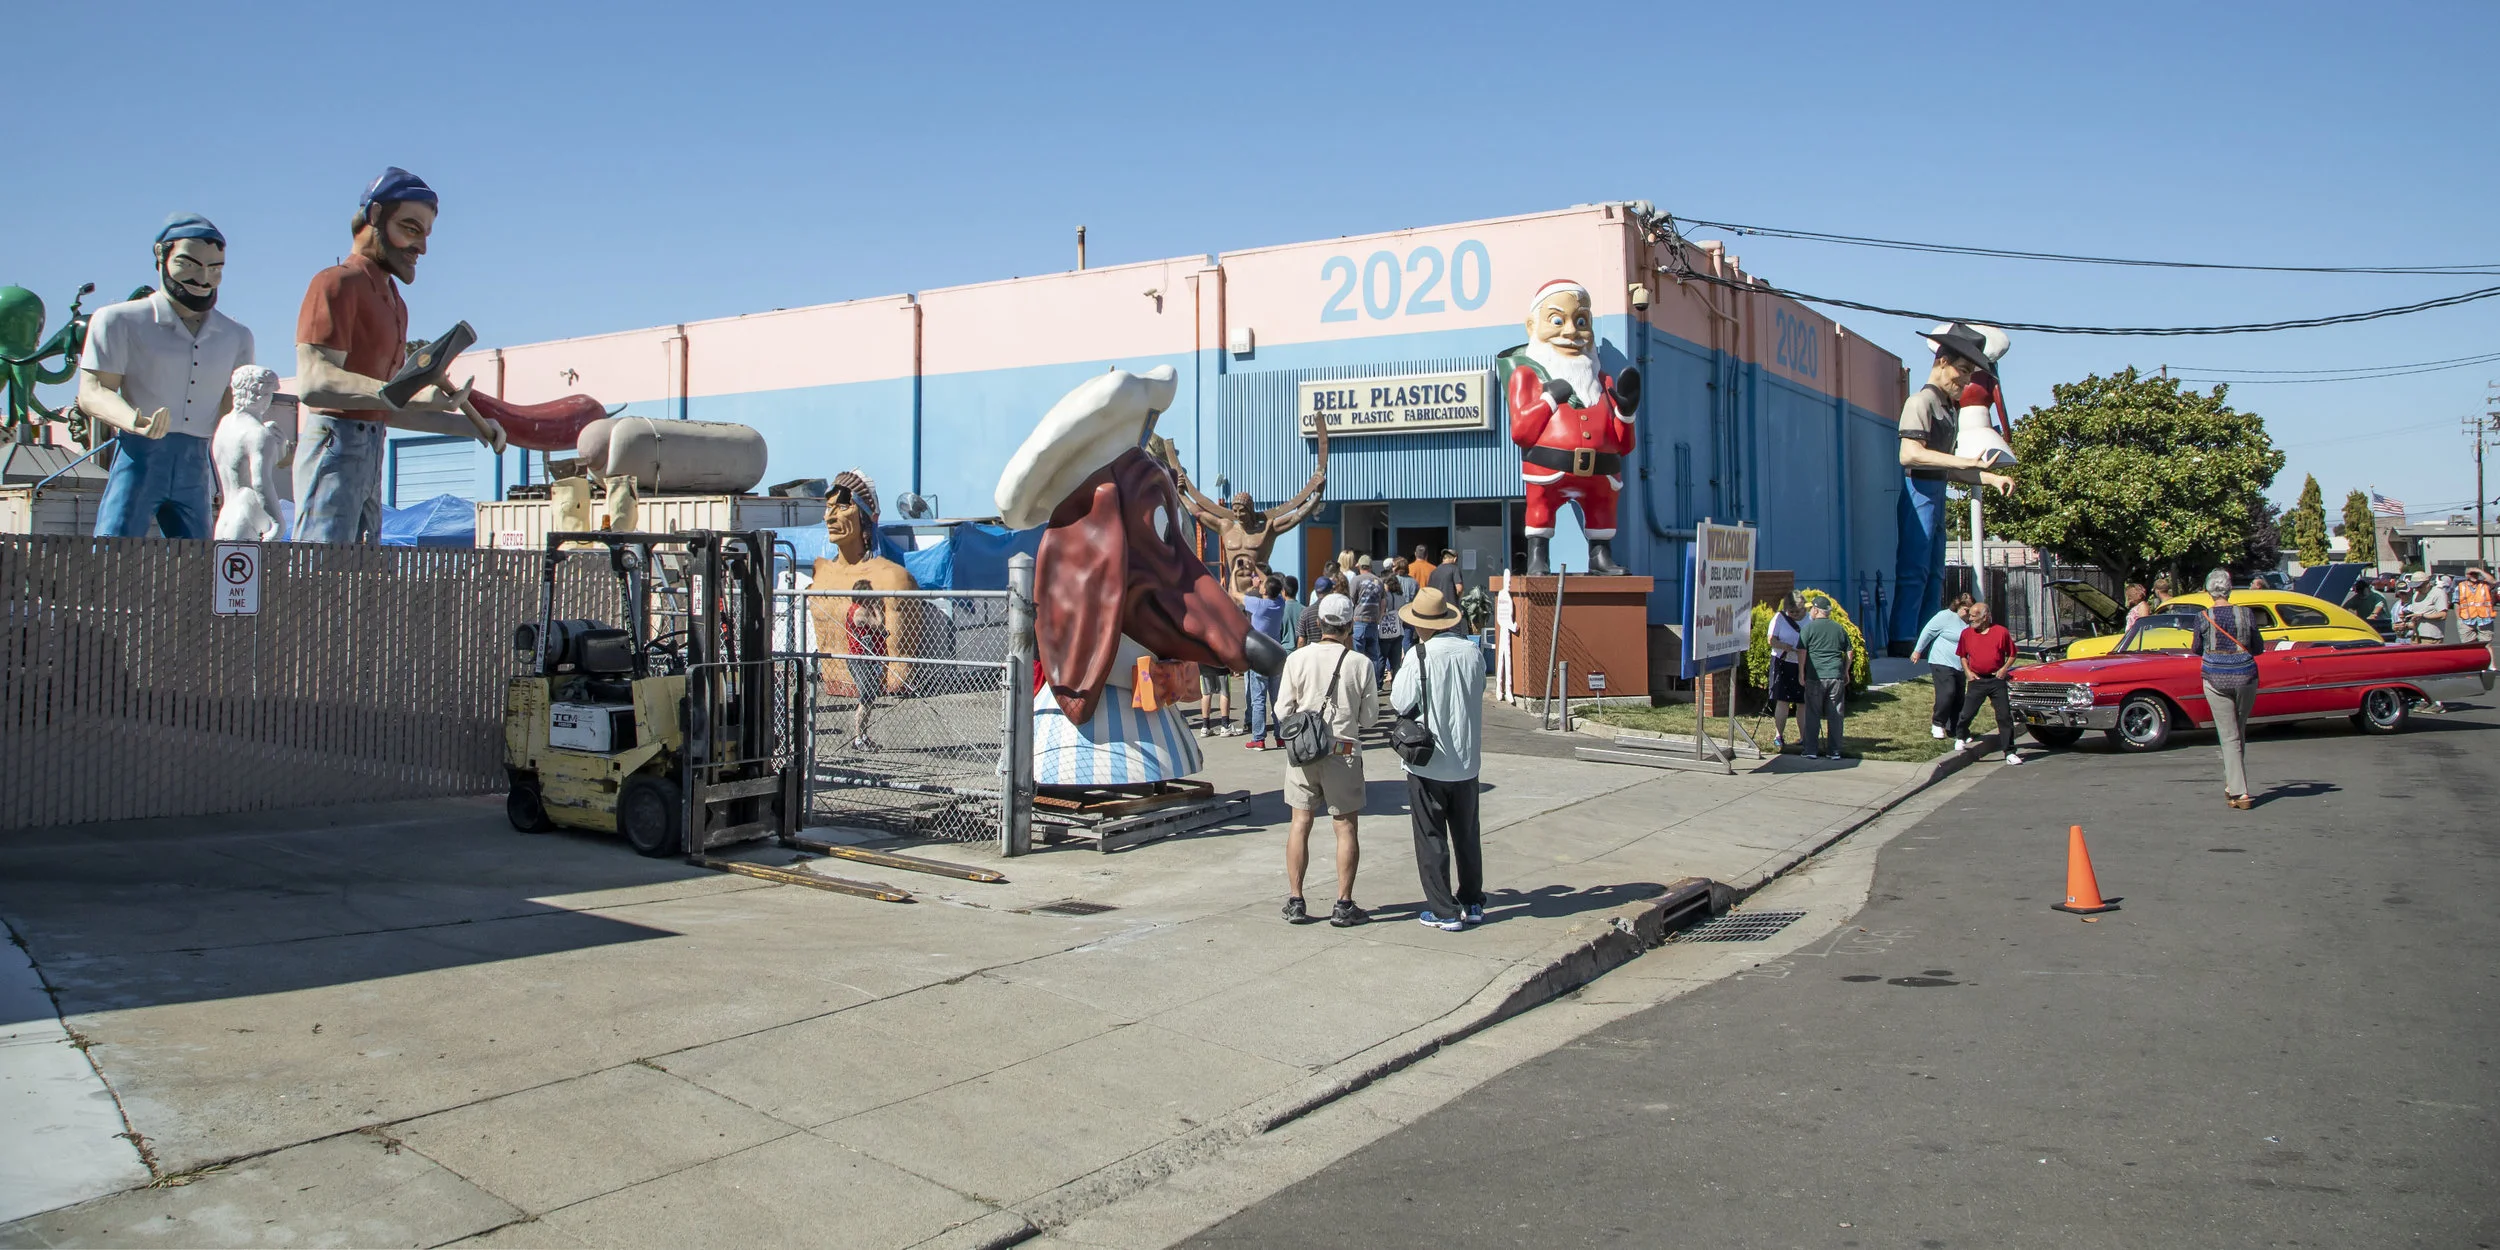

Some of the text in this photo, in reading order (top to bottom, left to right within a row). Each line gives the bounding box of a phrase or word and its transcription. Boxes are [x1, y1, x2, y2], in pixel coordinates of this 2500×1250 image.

[1320, 239, 1492, 324] 2020
[1776, 308, 1818, 379] 2020
[1313, 382, 1467, 411] BELL PLASTICS
[1303, 406, 1480, 427] CUOM PLASTIC FABRICATIONS
[503, 533, 524, 546] OFFICE
[1706, 528, 1750, 562] WELCOME
[1710, 566, 1721, 581] BELL
[229, 588, 245, 596] ANY
[1709, 585, 1722, 600] OPEN
[1723, 585, 1738, 599] HOUSE
[228, 599, 246, 607] TIME
[553, 713, 578, 722] TCM
